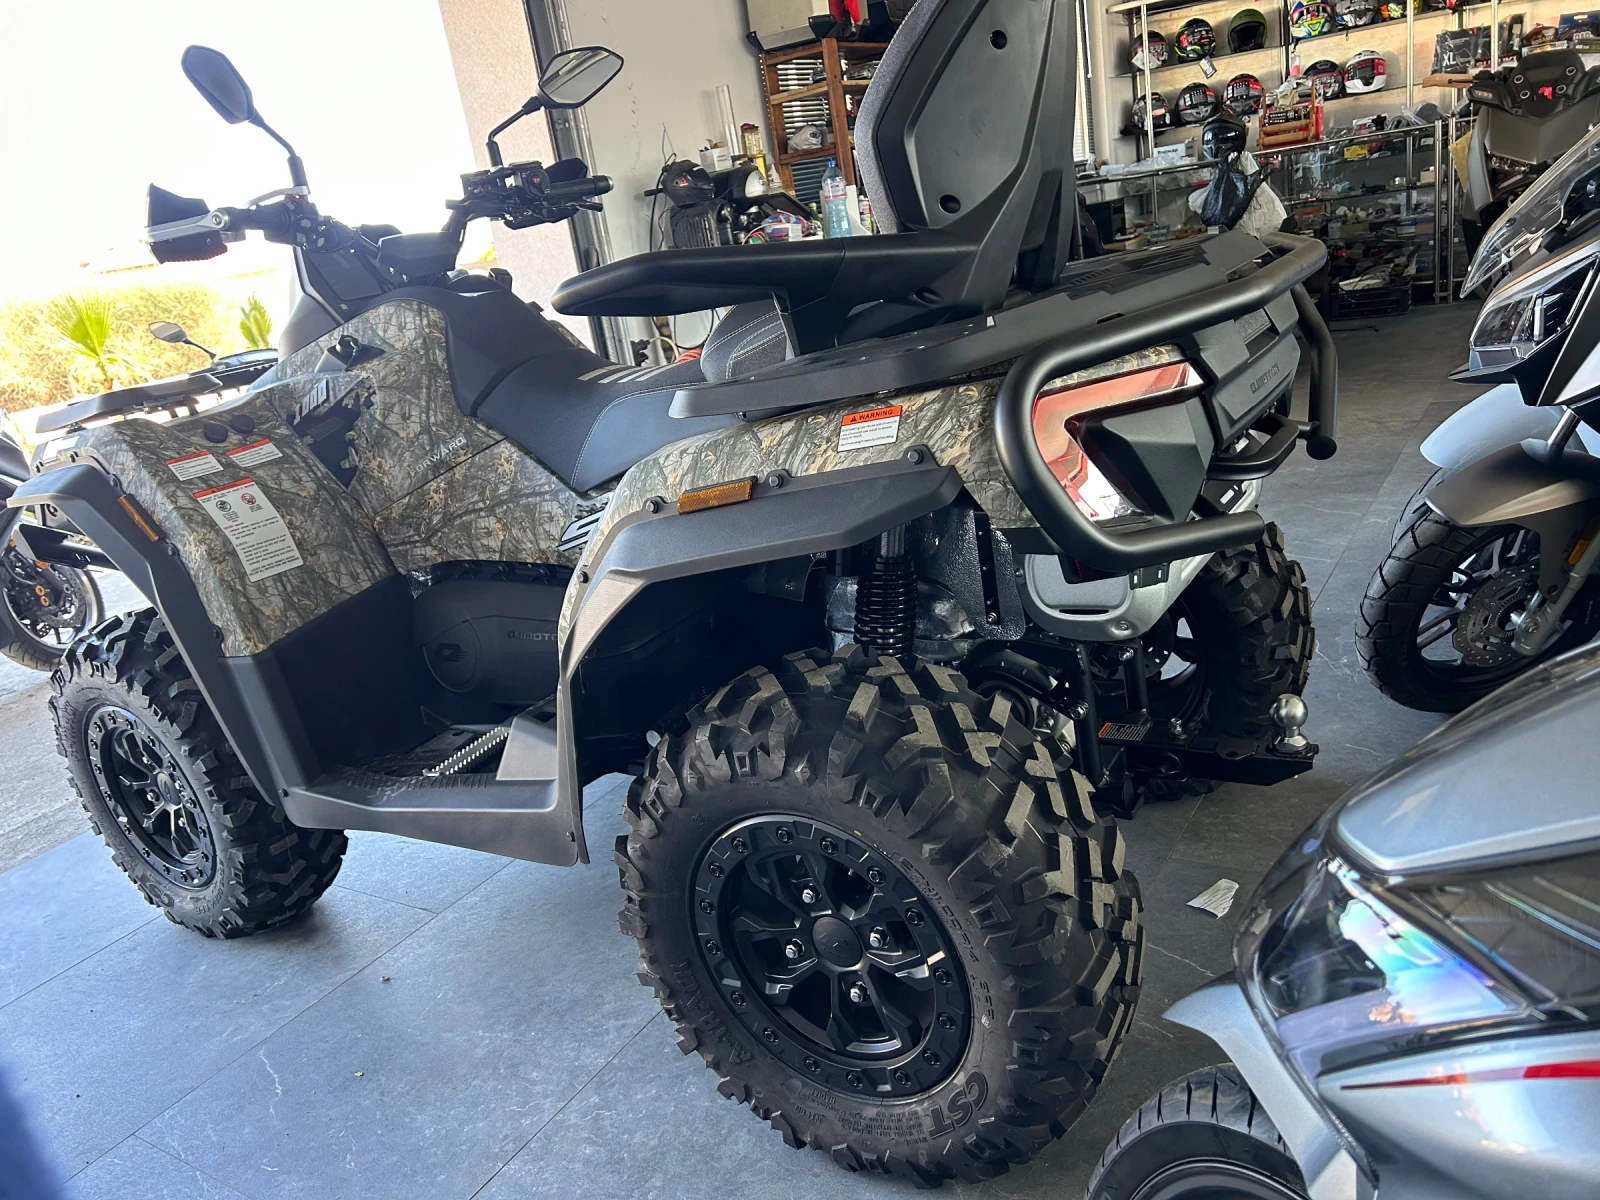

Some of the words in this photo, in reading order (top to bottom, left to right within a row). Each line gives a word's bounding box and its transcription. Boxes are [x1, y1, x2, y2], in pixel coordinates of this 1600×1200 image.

[1443, 51, 1457, 66] XL
[1474, 55, 1517, 68] SUUKI
[294, 377, 329, 426] 1000
[859, 409, 893, 420] WARNING
[410, 437, 465, 476] FORWARD
[928, 1071, 988, 1139] CST
